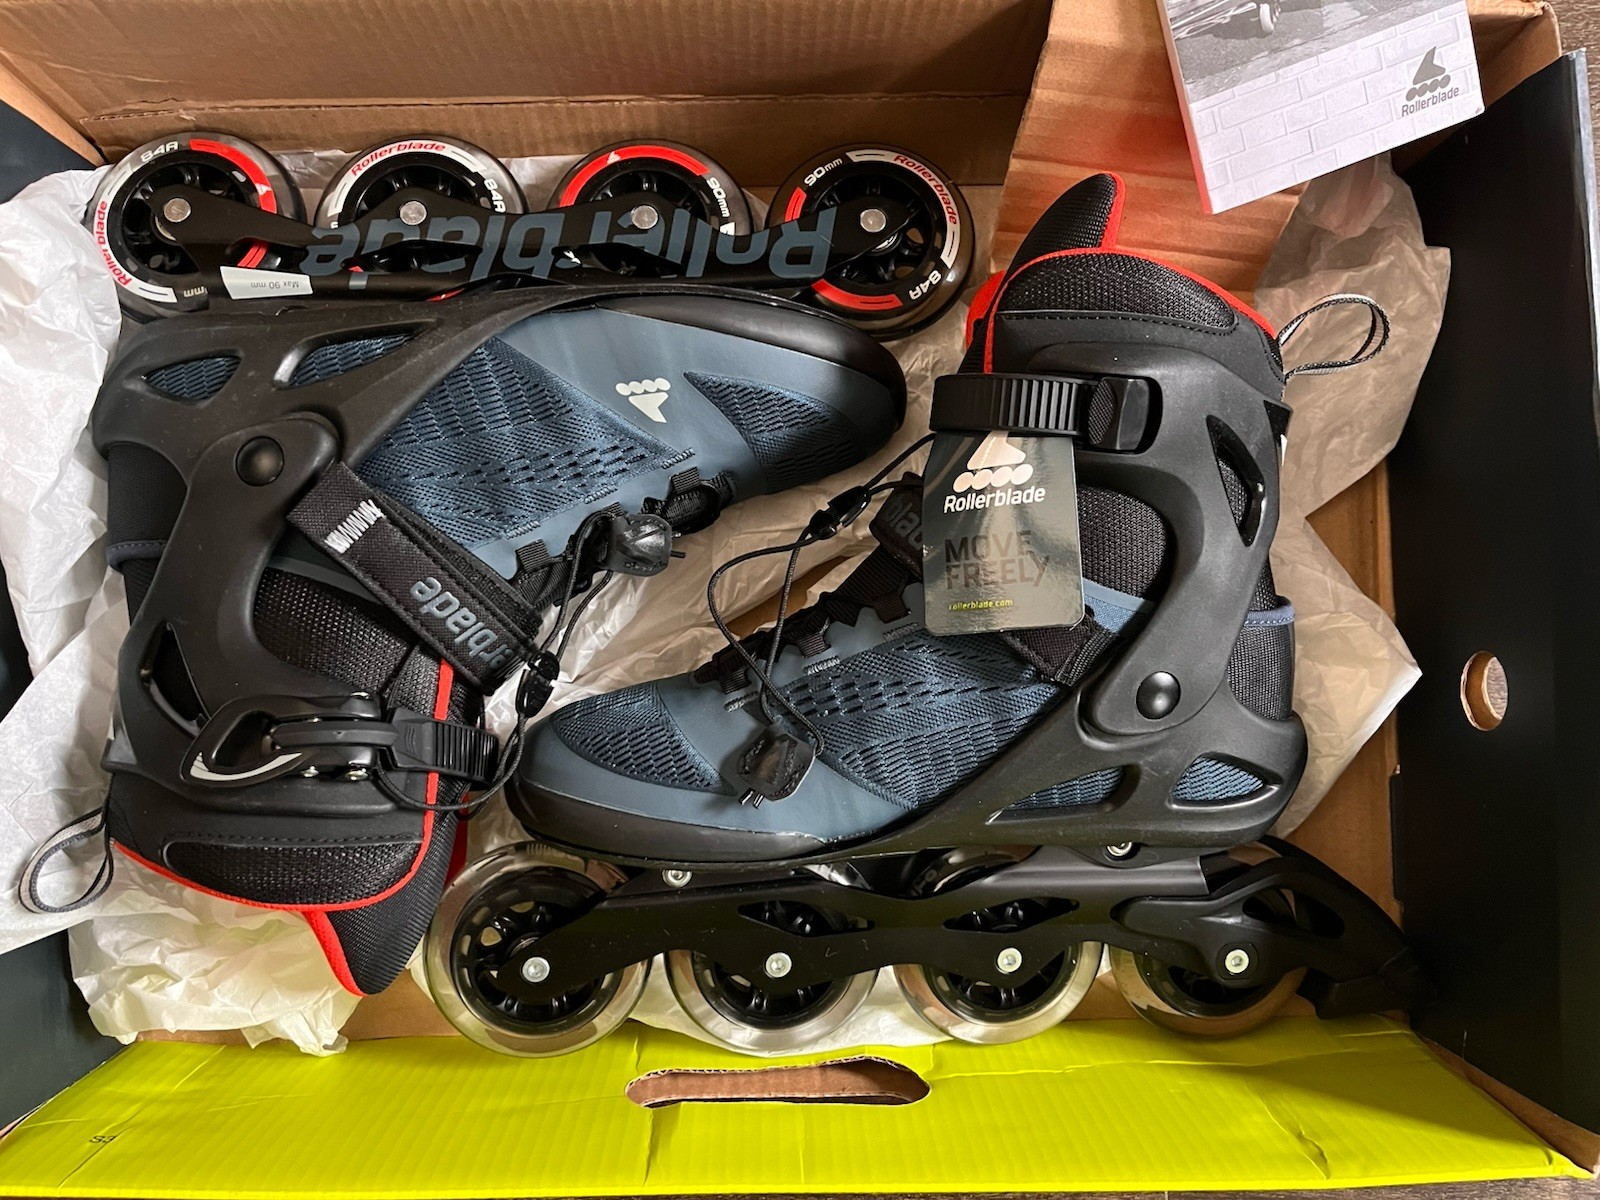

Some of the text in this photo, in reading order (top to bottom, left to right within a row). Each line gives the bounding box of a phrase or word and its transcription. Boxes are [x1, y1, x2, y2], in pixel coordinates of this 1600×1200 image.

[1402, 87, 1459, 117] Rollerblade
[140, 141, 179, 163] 84A
[352, 140, 447, 177] Rollerblade
[804, 157, 844, 187] 90mm
[484, 178, 506, 213] 84A
[705, 177, 730, 217] 90mm
[893, 154, 958, 226] Rollerblade
[96, 201, 133, 286] Rollerblade
[908, 269, 942, 300] 84A
[943, 485, 1046, 513] Rollerblade
[945, 531, 1032, 563] MOVE
[946, 555, 1050, 589] FREELY
[948, 599, 1014, 611] rollerblade.com
